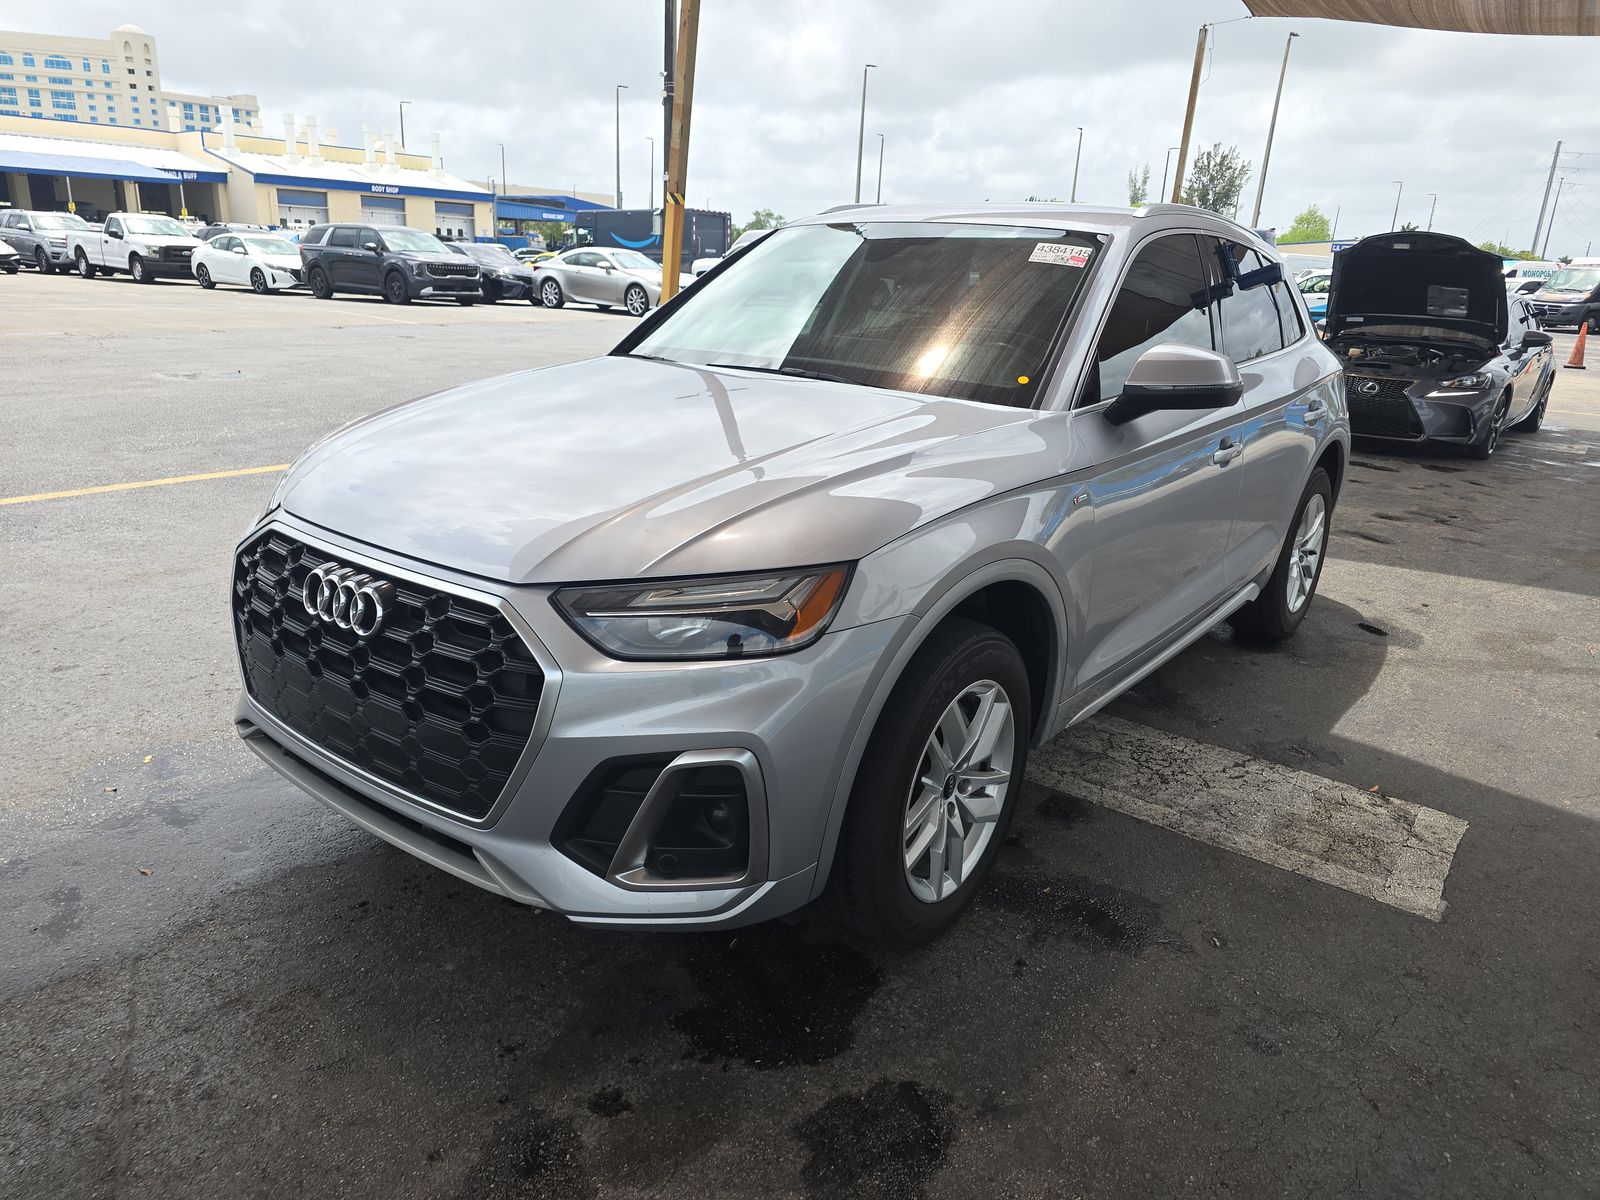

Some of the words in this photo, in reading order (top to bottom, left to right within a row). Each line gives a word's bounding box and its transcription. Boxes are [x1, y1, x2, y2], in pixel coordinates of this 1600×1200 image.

[183, 172, 198, 180] BUFF
[371, 185, 385, 193] BODY
[386, 186, 399, 194] SHOP
[1037, 245, 1090, 258] 4384145
